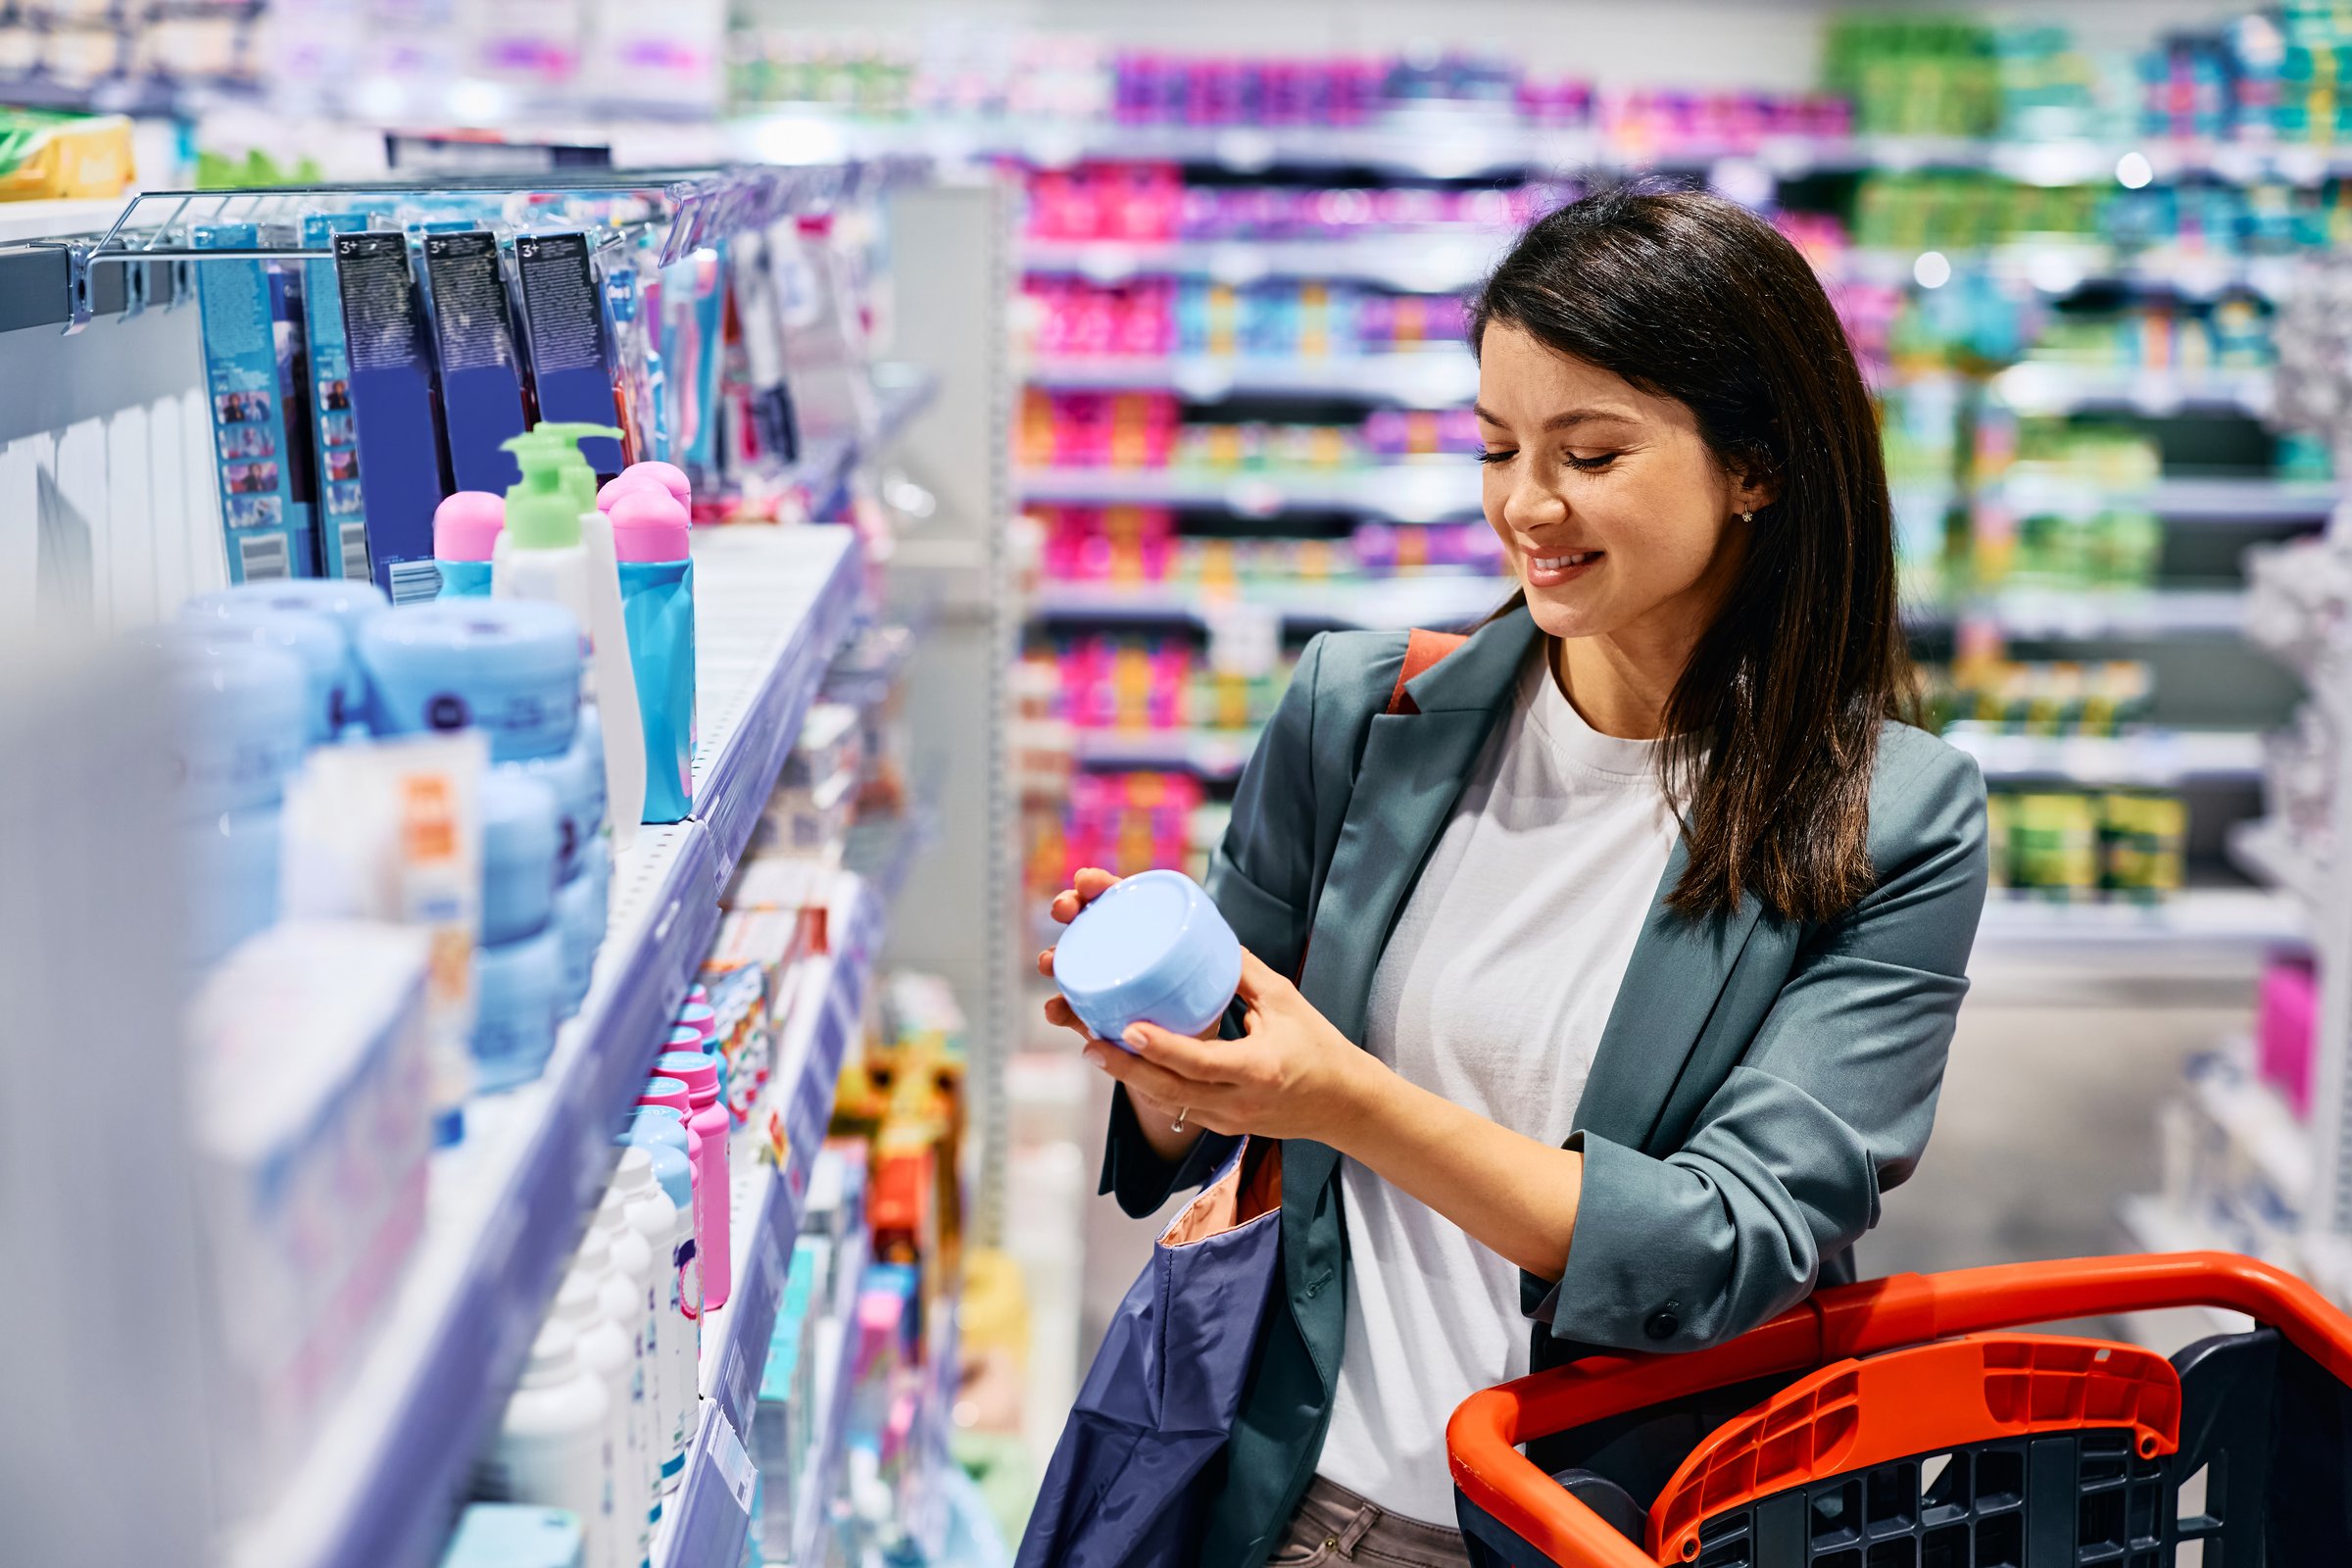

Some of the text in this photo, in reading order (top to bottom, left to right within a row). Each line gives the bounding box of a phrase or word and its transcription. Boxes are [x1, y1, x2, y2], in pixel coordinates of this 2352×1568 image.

[340, 241, 358, 254] 3+
[429, 240, 447, 254] 3+
[522, 243, 539, 257] 3+
